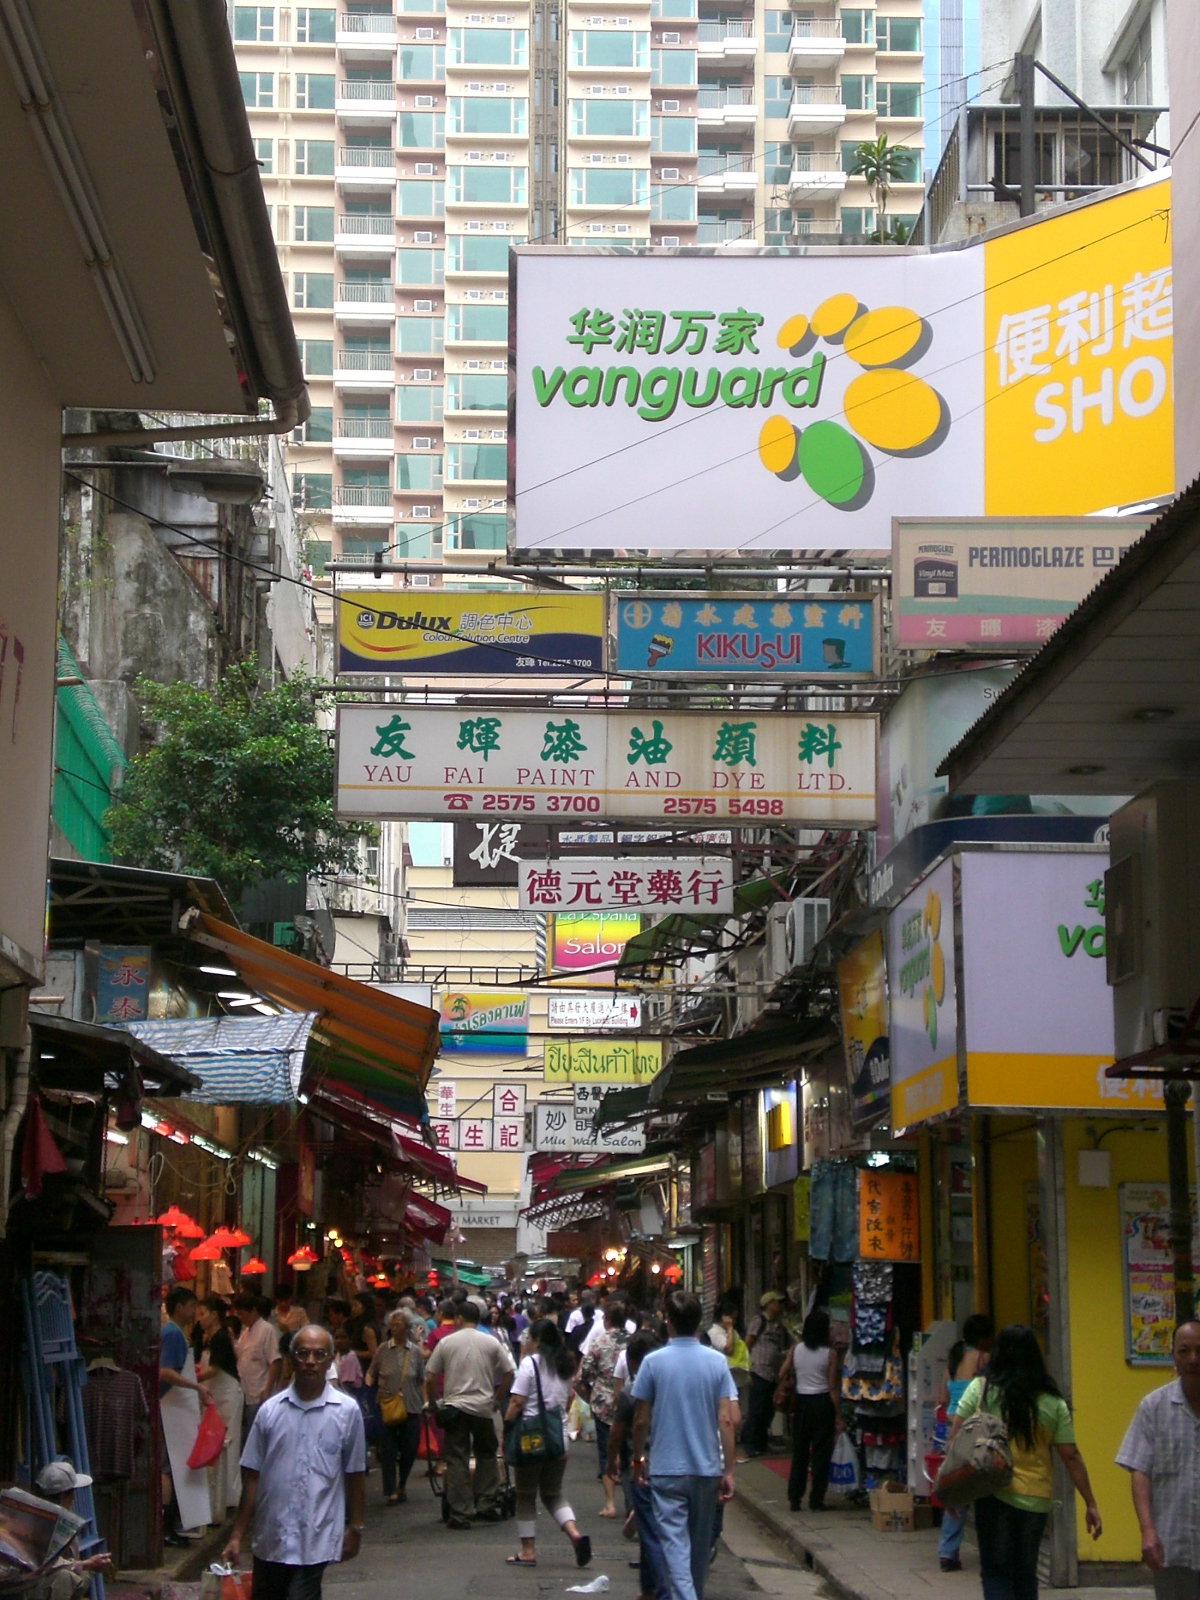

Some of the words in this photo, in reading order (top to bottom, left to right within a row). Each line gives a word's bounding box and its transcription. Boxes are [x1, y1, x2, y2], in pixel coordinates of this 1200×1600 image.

[566, 306, 764, 355] 华润万家
[531, 351, 827, 422] vanguard
[968, 546, 1085, 567] PERMOGLAZE
[376, 611, 452, 630] Dulux
[459, 612, 533, 631] 調色中心
[422, 632, 453, 643] Colour
[455, 633, 496, 643] Solution
[497, 633, 530, 643] Centre
[697, 633, 801, 668] KIKUSUI
[364, 765, 413, 782] YAU
[443, 767, 485, 784] FAI
[517, 768, 595, 786] PAINT
[625, 771, 682, 788] AND
[712, 771, 766, 789] DYE
[797, 773, 852, 791] LTD.
[482, 794, 536, 811] 2575
[546, 796, 601, 812] 3700
[663, 798, 717, 814] 2575
[728, 799, 784, 815] 5498
[526, 868, 724, 906] 德元堂藥行
[108, 964, 145, 1019] 永泰
[551, 1016, 564, 1024] Please
[541, 1136, 566, 1145] Miu
[603, 1136, 642, 1147] Salon
[462, 1216, 499, 1224] MARKET
